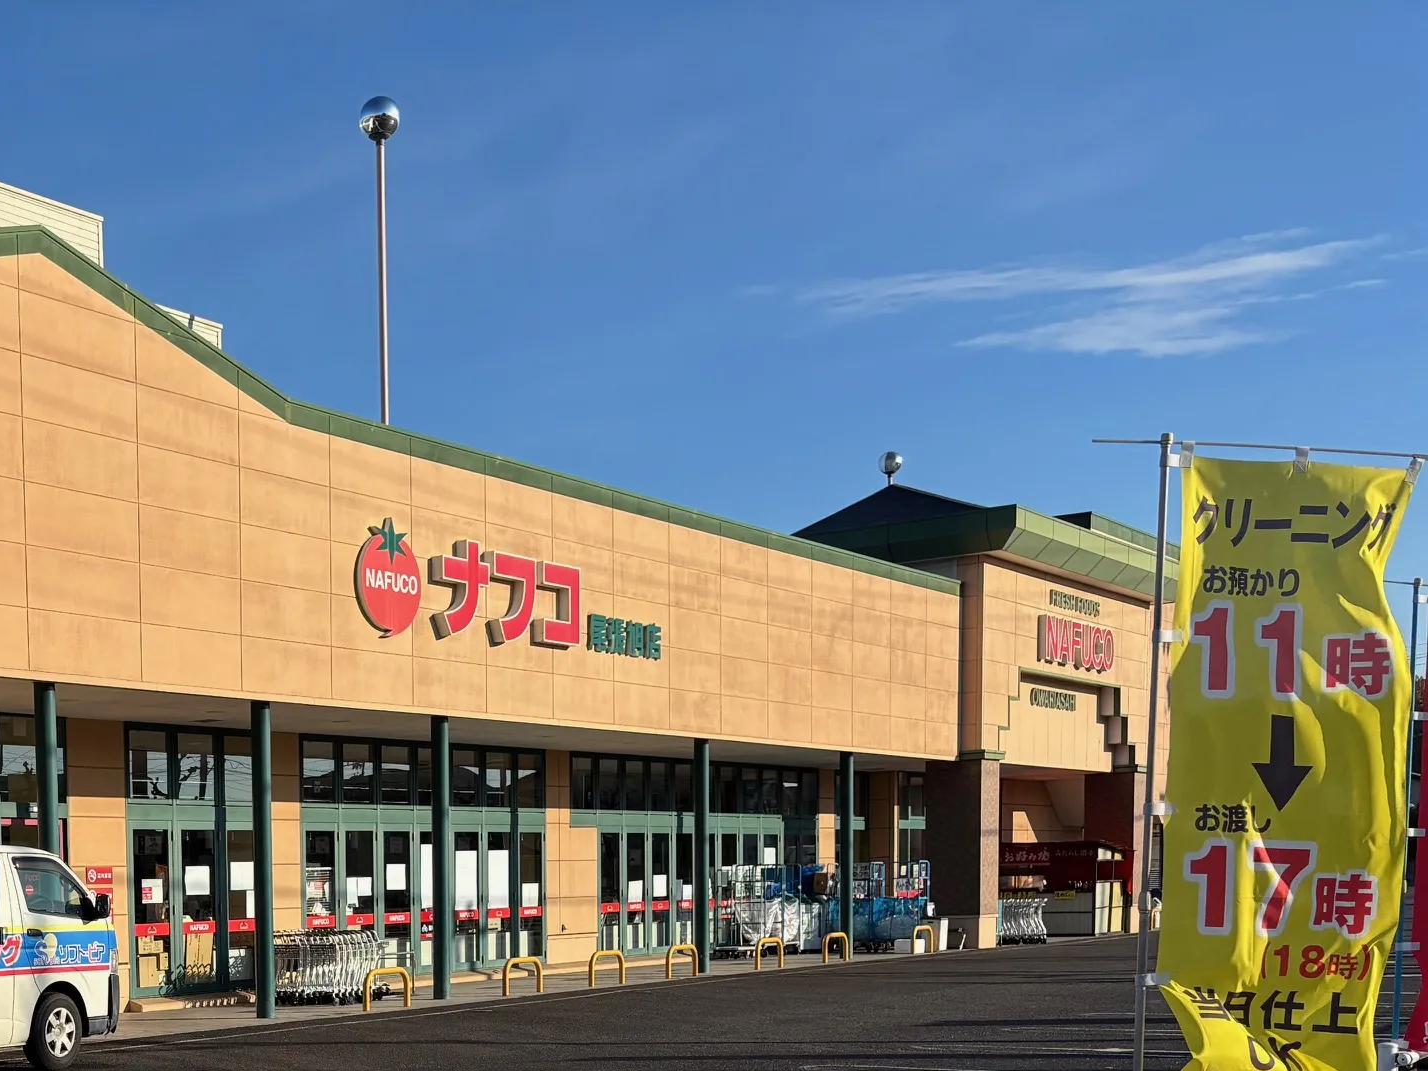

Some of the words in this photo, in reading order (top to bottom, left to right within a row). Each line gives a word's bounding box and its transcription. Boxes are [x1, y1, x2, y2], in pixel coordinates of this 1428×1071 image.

[1192, 495, 1398, 552] クリーニング
[364, 567, 419, 597] NAFUCO
[429, 539, 582, 649] ナフコ
[1050, 589, 1075, 611] FRESH
[1075, 597, 1100, 617] FOODS
[1202, 565, 1301, 597] お預かり
[1040, 614, 1115, 673] NAFUCO
[1190, 600, 1394, 700] 11時
[1194, 803, 1272, 833] お渡し
[1184, 838, 1378, 940] 17時
[1260, 943, 1371, 980] (18時)
[1183, 986, 1359, 1035] 当日仕上
